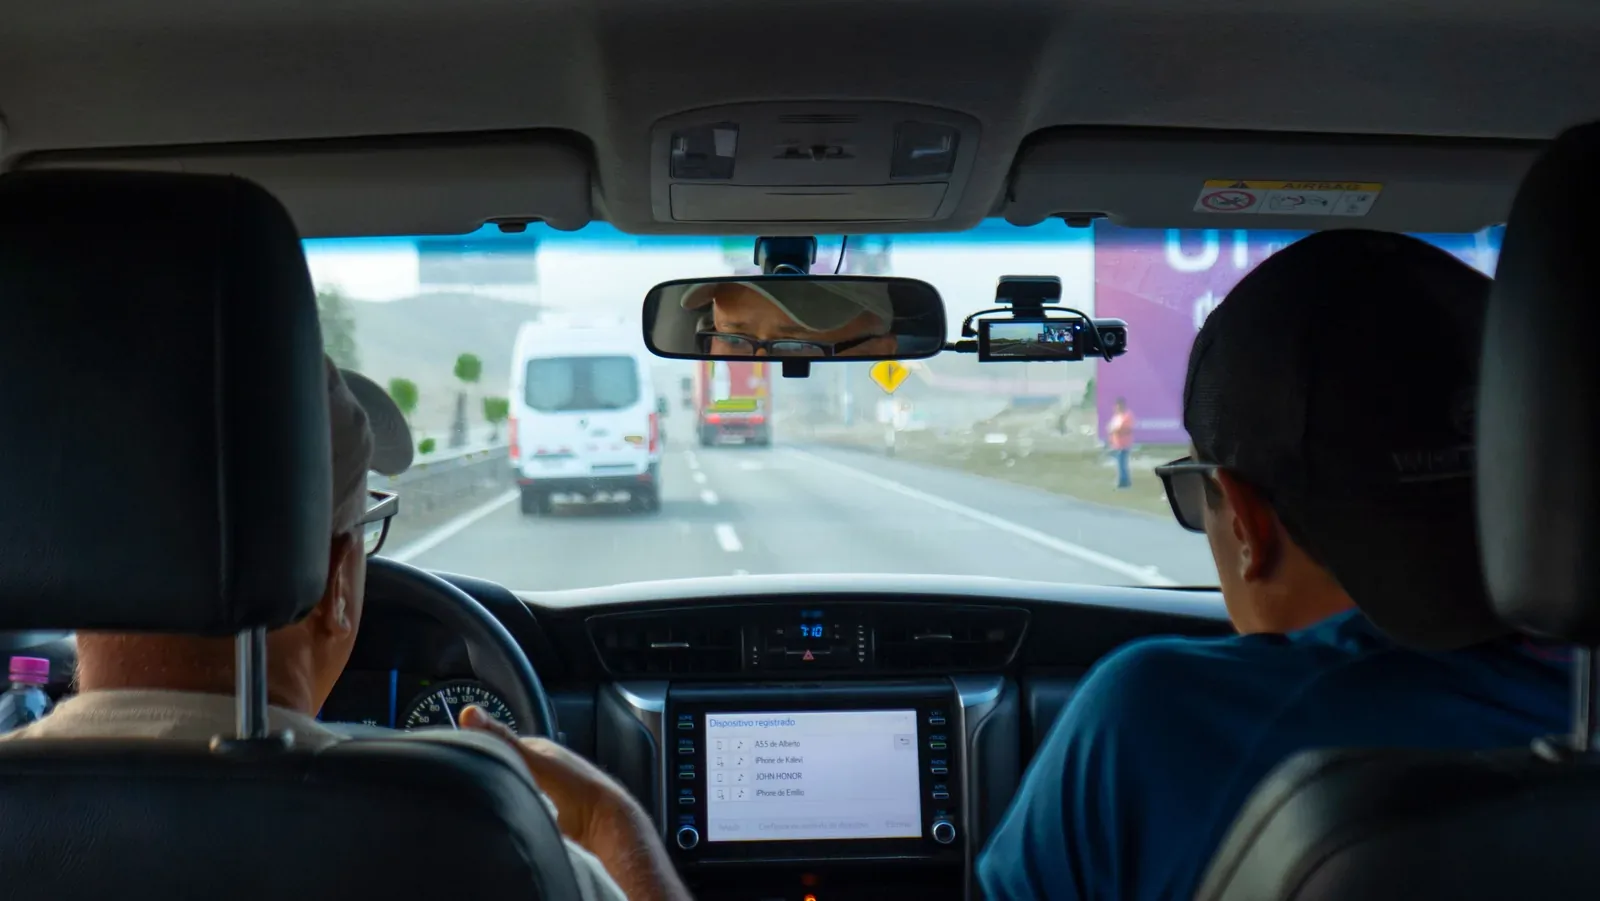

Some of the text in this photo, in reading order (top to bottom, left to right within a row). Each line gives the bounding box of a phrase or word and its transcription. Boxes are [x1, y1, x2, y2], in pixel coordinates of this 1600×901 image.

[1282, 182, 1362, 190] AIRBAG
[801, 626, 823, 637] 7:10
[430, 704, 440, 712] 80
[709, 718, 796, 729] Dispositivo registrado
[786, 788, 805, 796] Emilio
